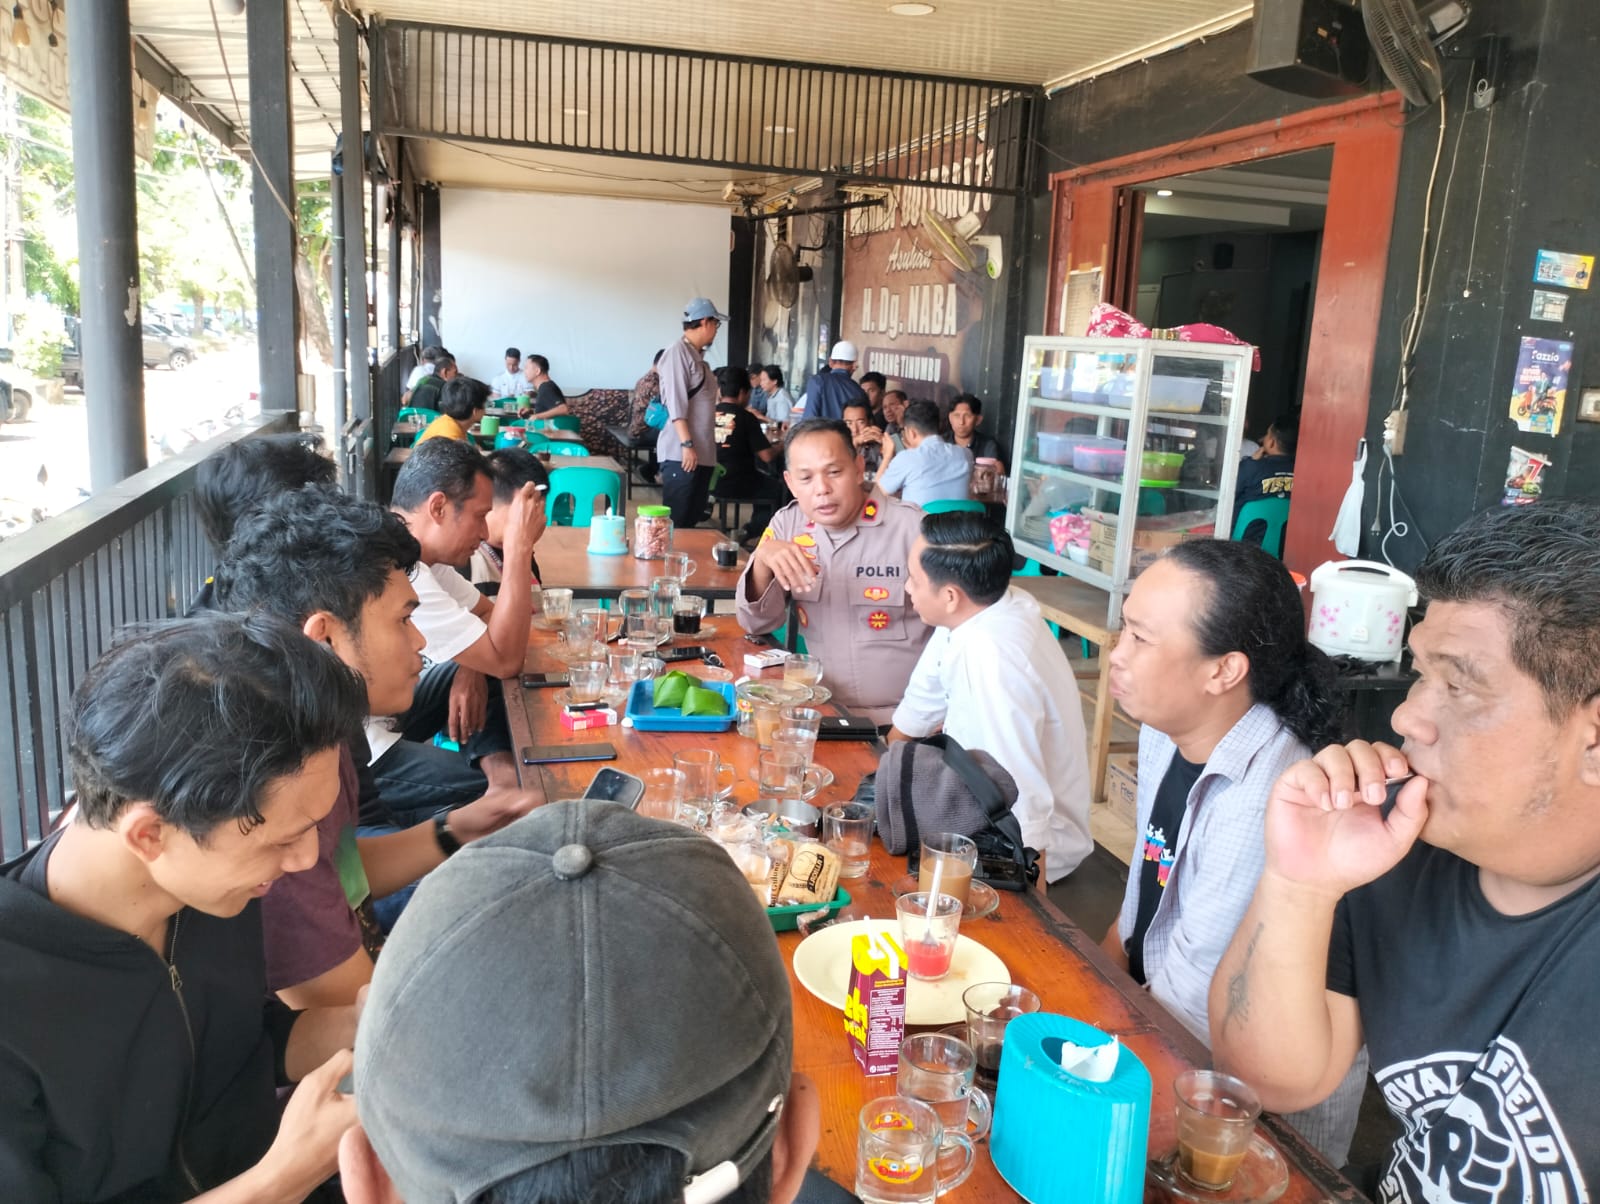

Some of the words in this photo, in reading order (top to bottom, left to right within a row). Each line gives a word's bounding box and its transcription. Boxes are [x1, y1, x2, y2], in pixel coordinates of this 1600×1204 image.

[862, 287, 875, 333] H.
[878, 286, 903, 340] Dg.
[908, 283, 957, 335] NABA
[856, 566, 900, 577] POLRI
[1382, 1064, 1464, 1110] OYAL
[1478, 1048, 1560, 1165] FIELD
